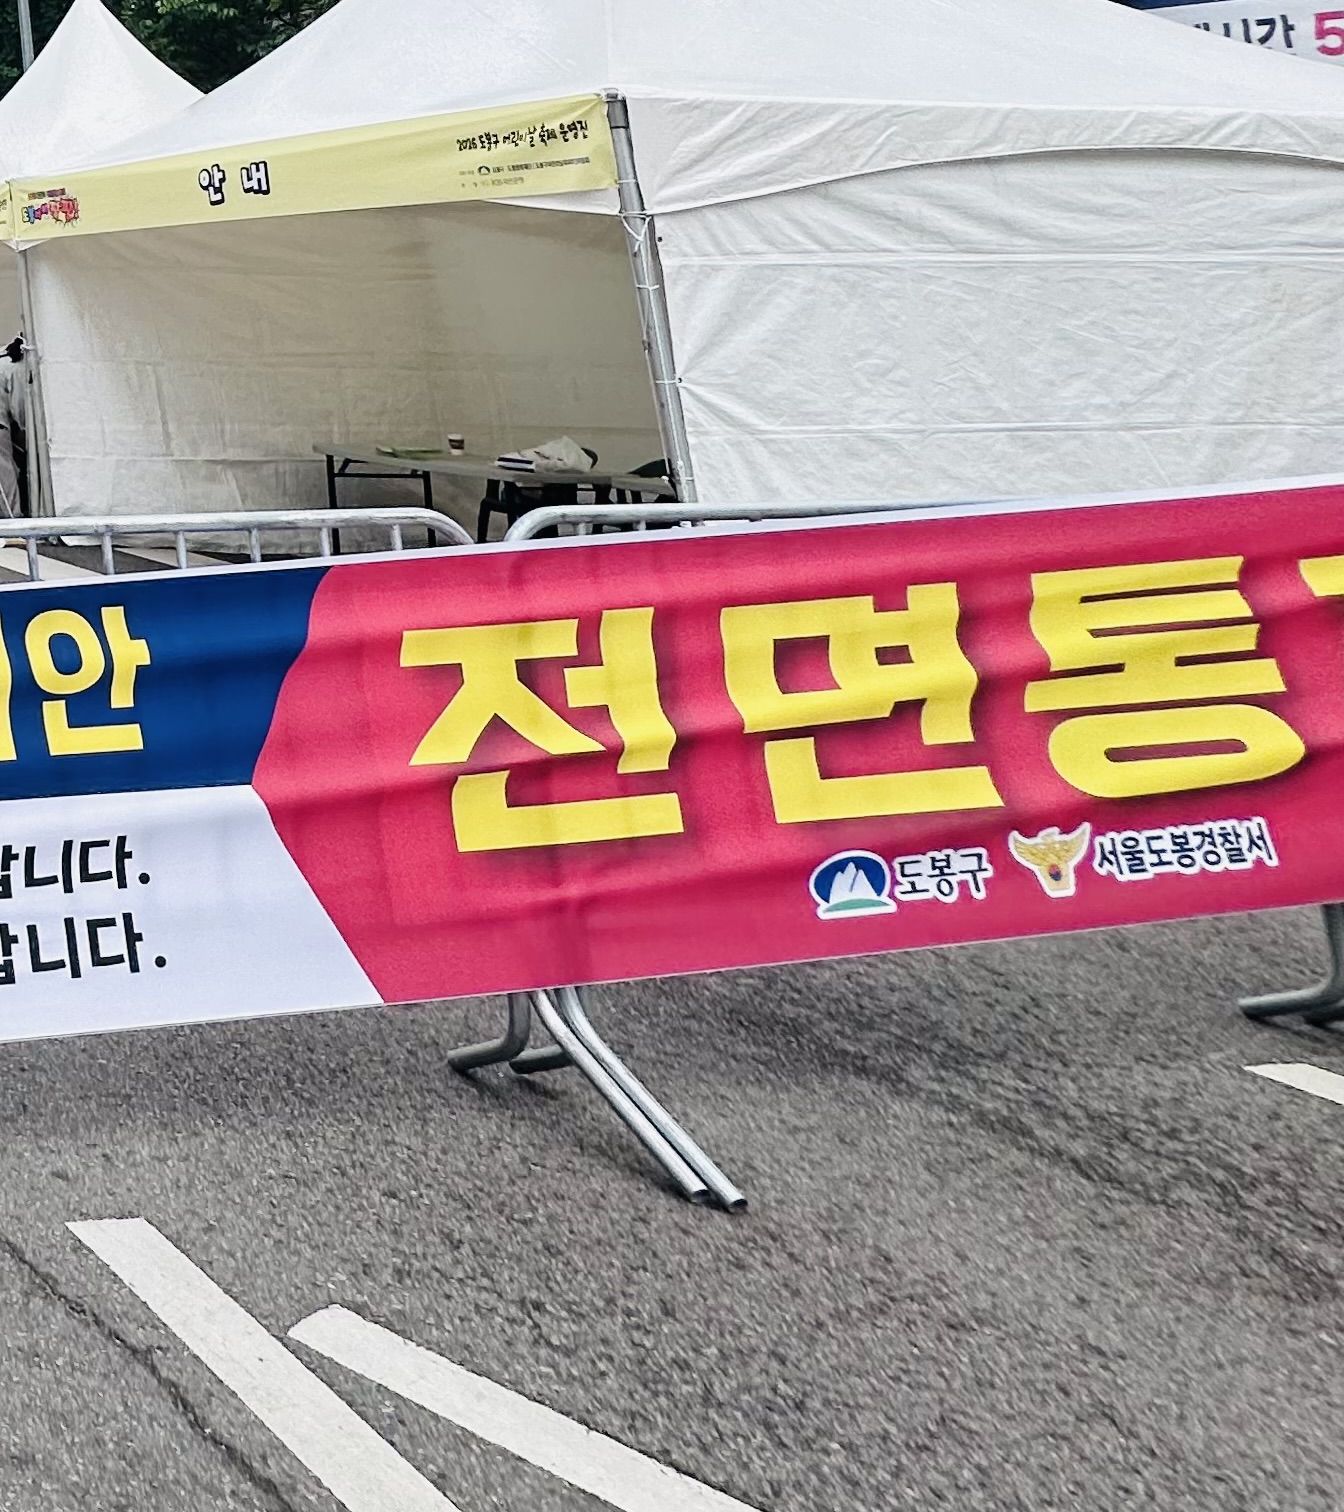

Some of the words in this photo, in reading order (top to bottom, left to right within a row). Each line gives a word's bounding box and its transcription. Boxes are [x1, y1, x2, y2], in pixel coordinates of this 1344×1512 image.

[198, 163, 227, 206] 안
[240, 160, 271, 195] 내
[1096, 820, 1275, 876] 서울도봉경찰서
[898, 852, 991, 900] 도봉구
